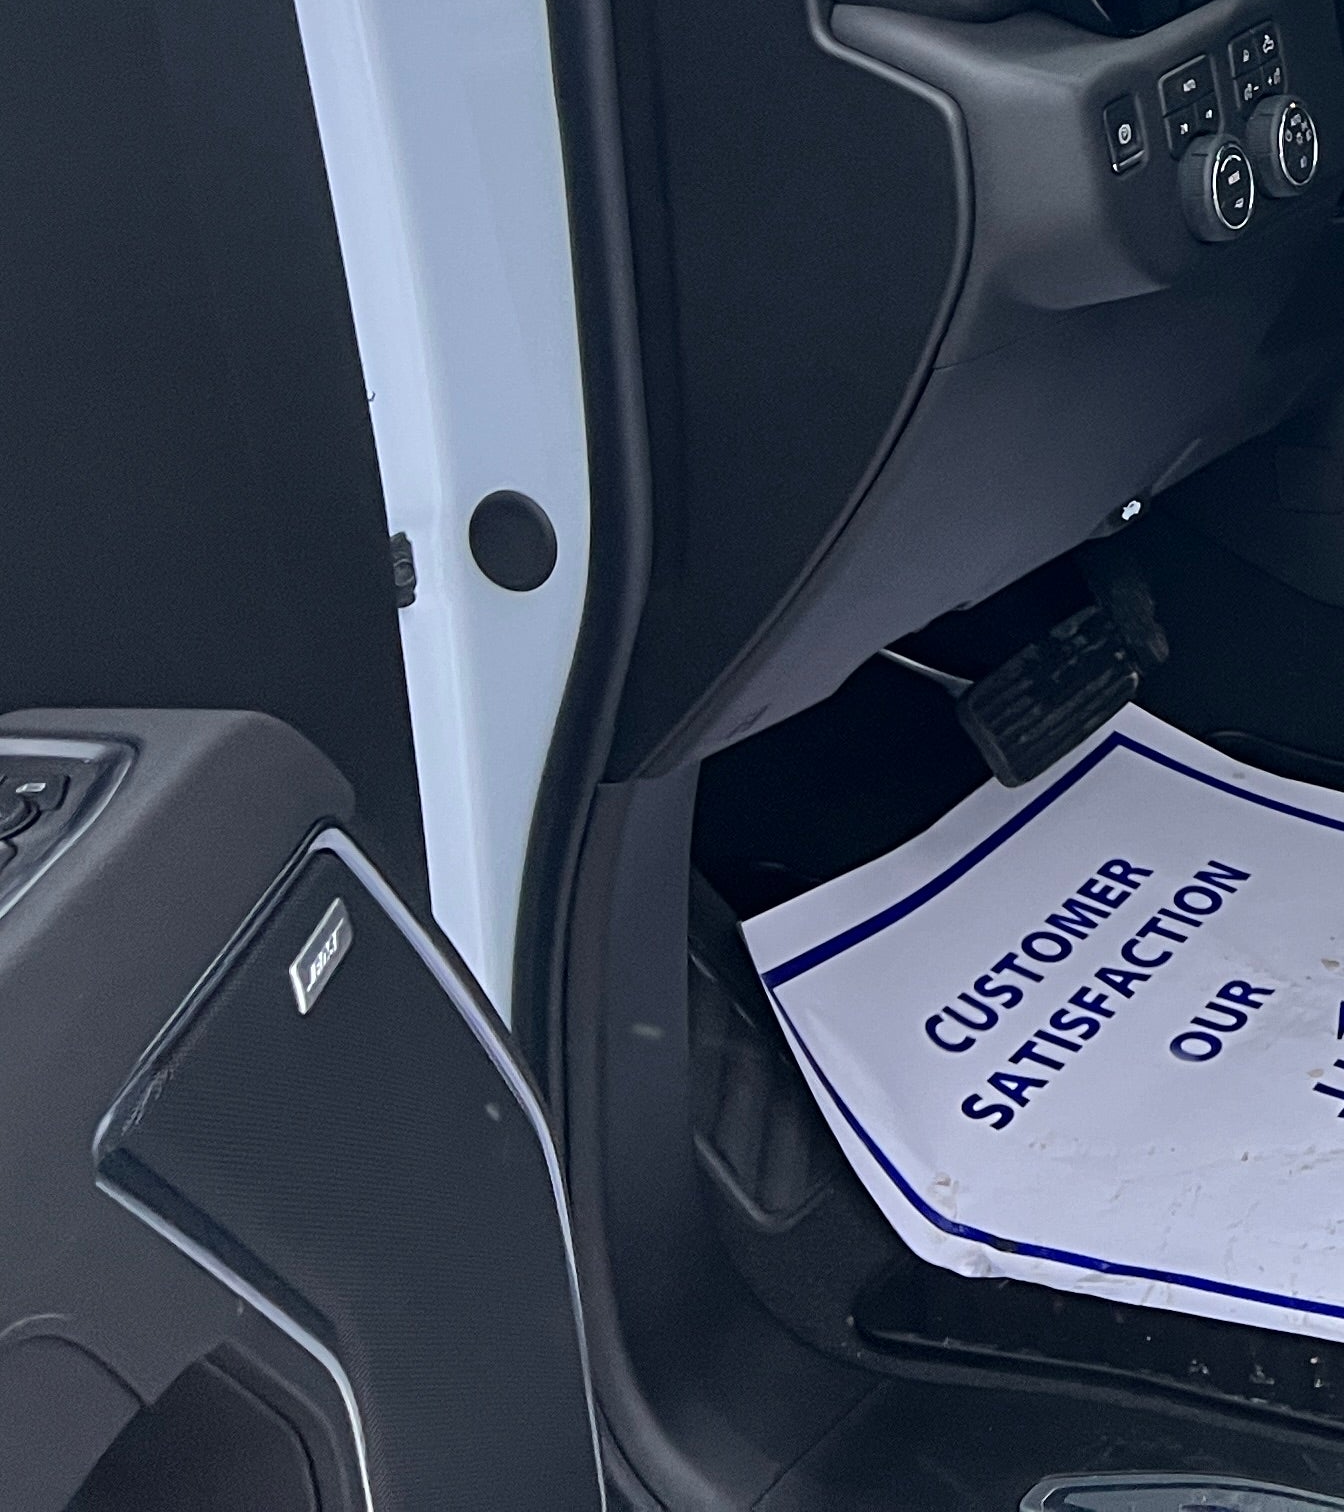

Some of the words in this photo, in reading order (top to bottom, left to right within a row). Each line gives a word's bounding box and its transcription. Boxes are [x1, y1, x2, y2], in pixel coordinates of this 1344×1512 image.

[926, 858, 1154, 1054] CUSTOMER
[962, 859, 1250, 1130] SATISFACTION
[1168, 979, 1274, 1063] OUR
